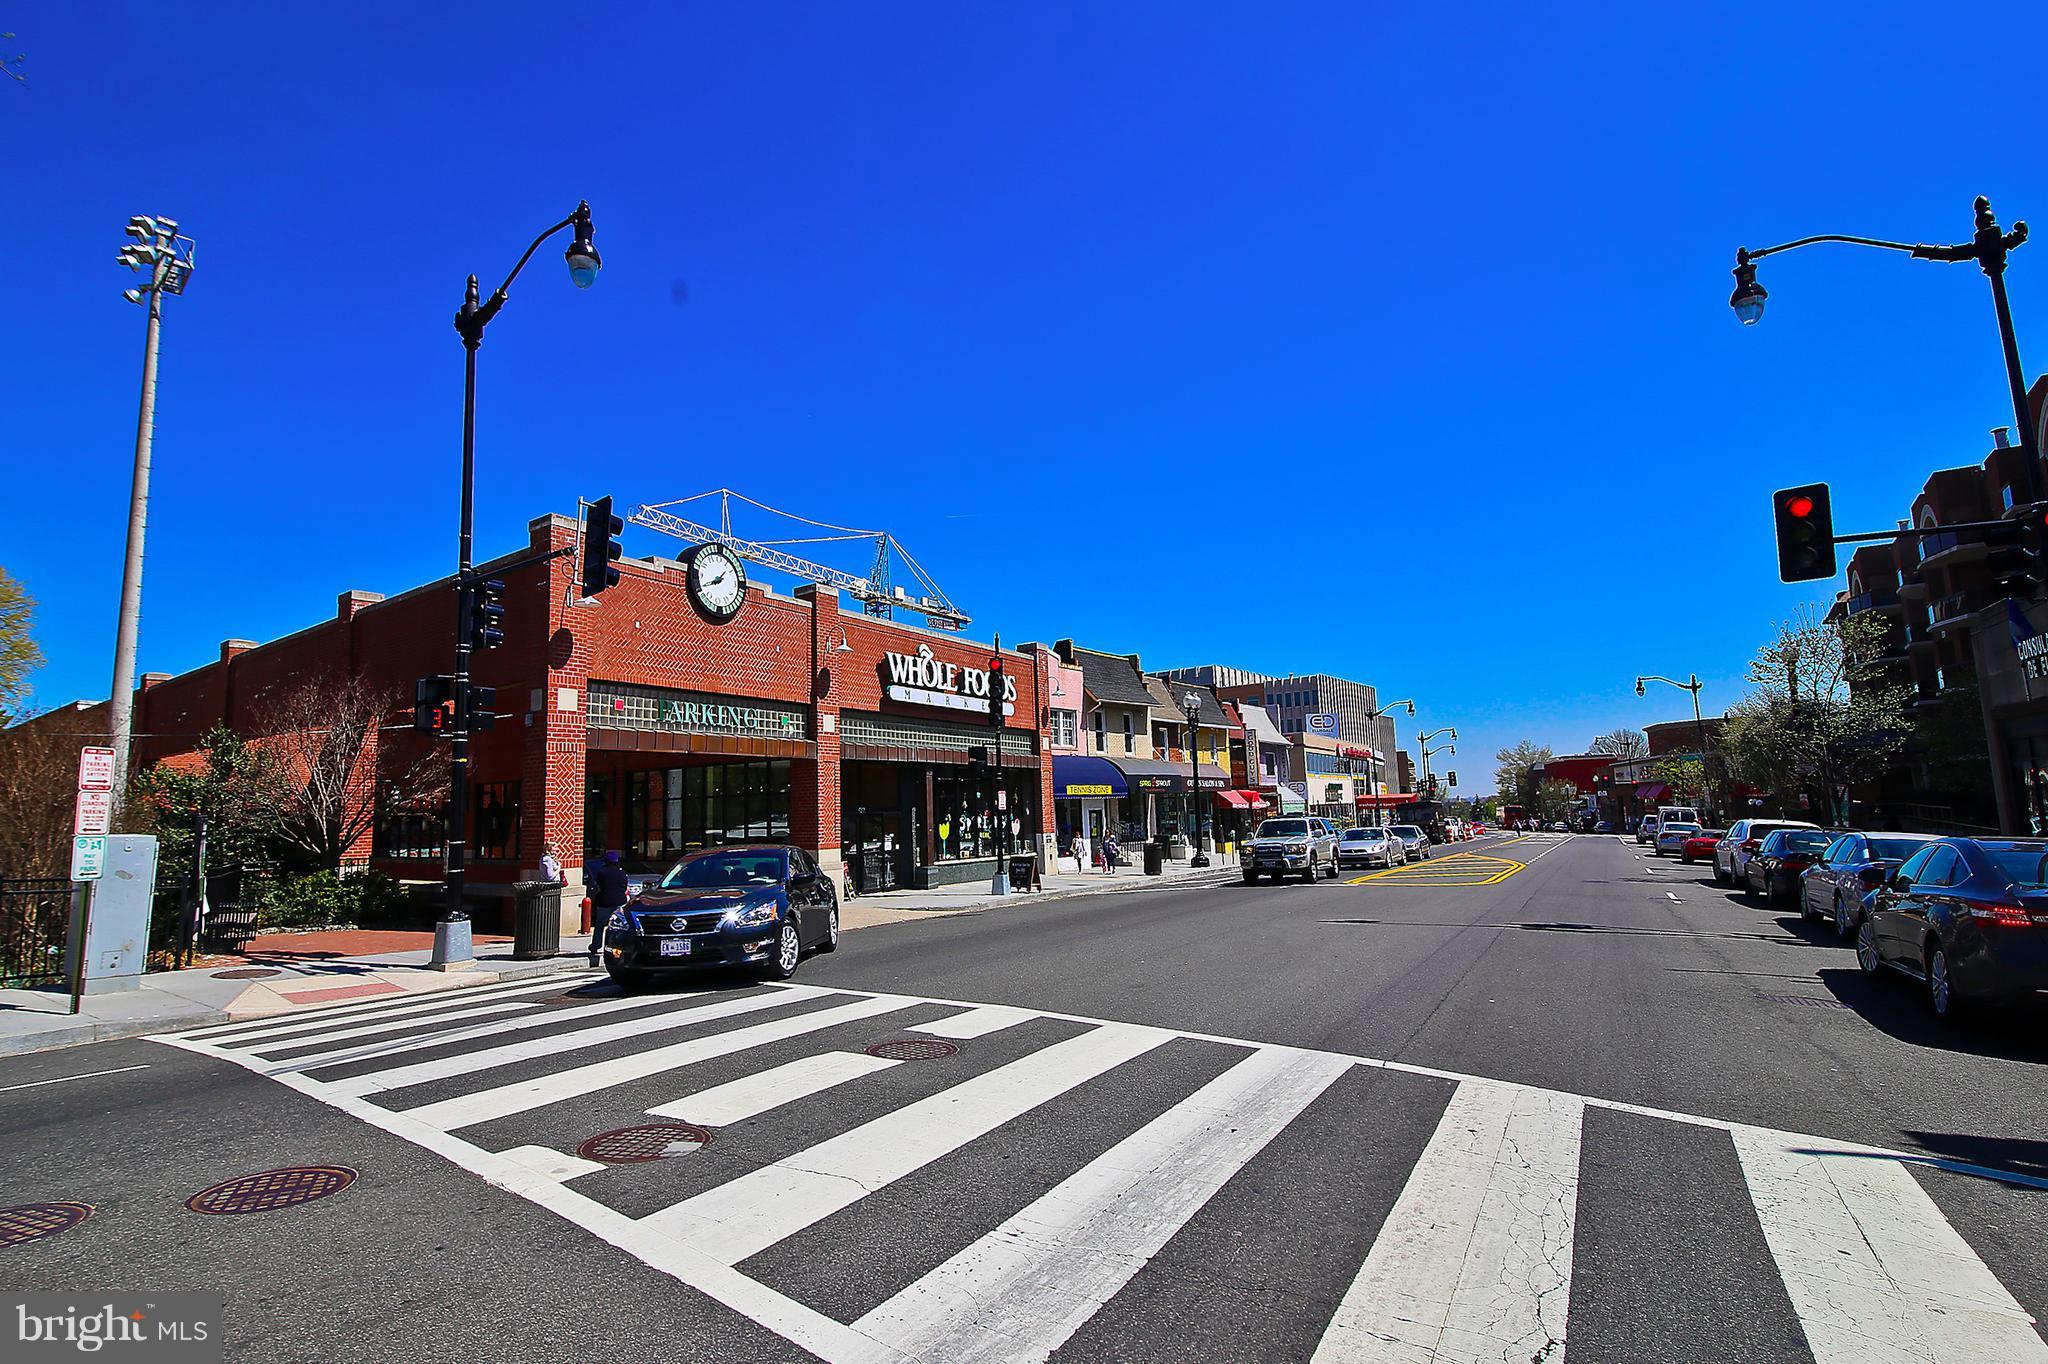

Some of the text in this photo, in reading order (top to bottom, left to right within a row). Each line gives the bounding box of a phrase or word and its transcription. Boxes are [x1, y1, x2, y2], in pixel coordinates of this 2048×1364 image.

[886, 644, 959, 692] WHOLE
[2027, 660, 2039, 679] DE
[904, 689, 987, 711] MARKE
[657, 698, 758, 729] PARKING
[1070, 785, 1092, 793] TENNIS
